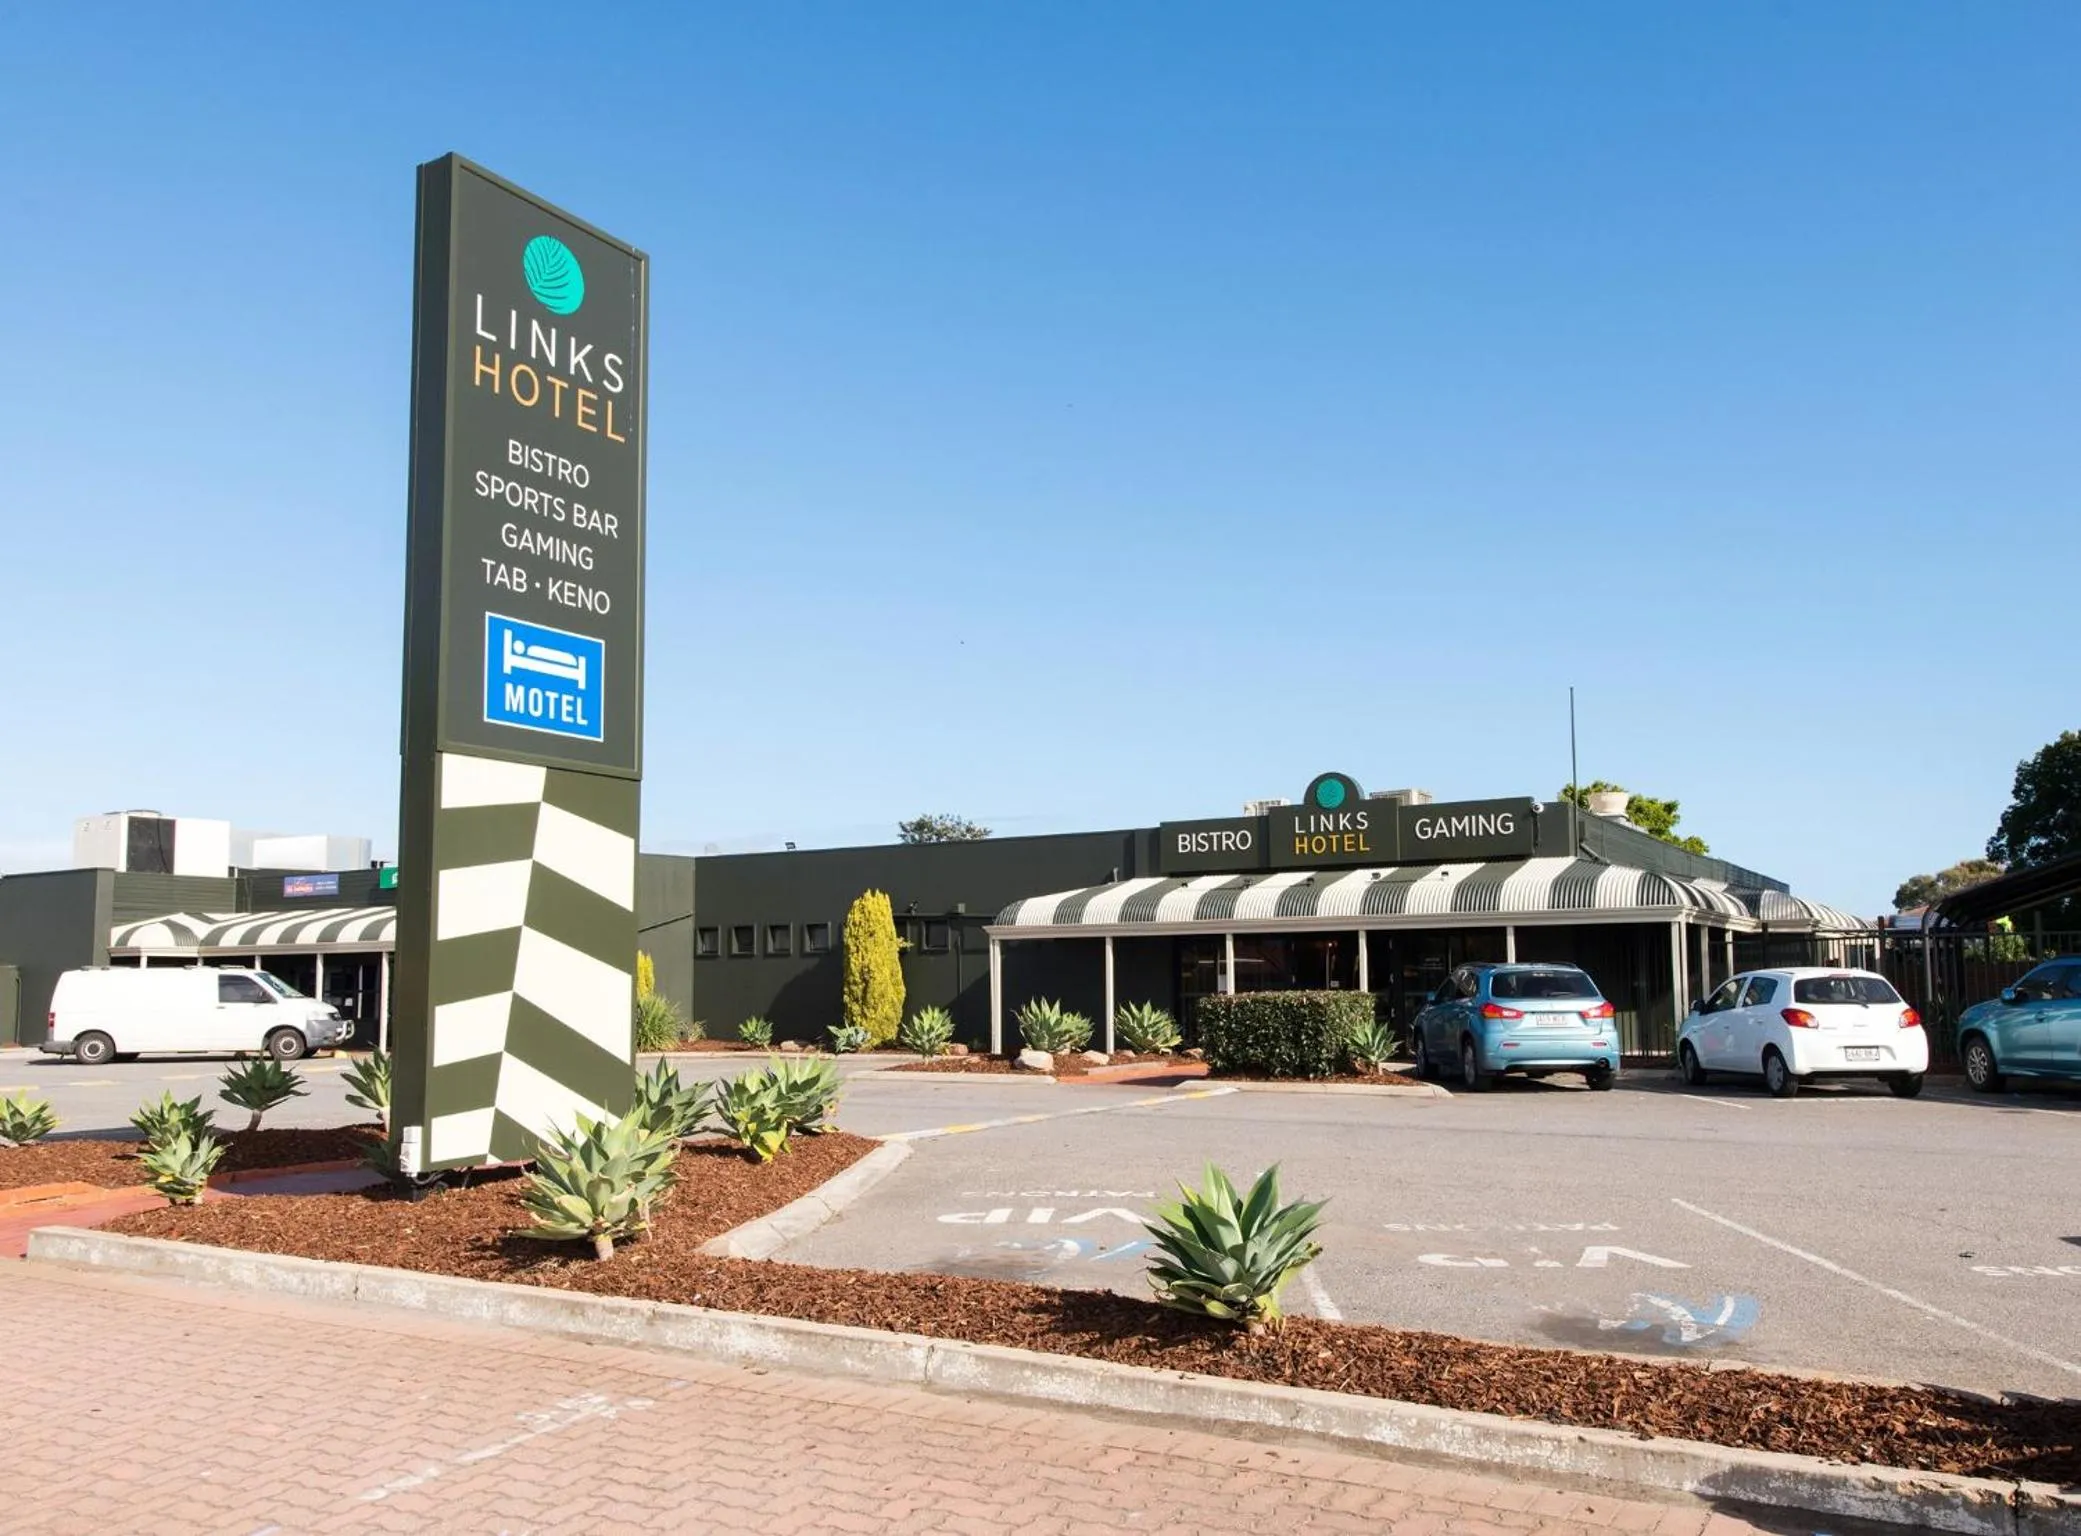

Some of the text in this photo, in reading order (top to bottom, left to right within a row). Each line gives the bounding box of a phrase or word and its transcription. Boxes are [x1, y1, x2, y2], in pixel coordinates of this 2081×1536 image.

[475, 293, 624, 394] LINKS
[474, 344, 626, 443] HOTEL
[508, 439, 590, 488] BISTRO
[475, 470, 619, 539] SPORTS BAR
[501, 522, 594, 570] GAMING
[481, 557, 611, 615] TAB KENO
[504, 682, 588, 726] MOTEL
[1177, 829, 1252, 853] BISTRO
[1294, 811, 1369, 834] LINKS
[1295, 832, 1370, 855] HOTEL
[1415, 812, 1515, 840] GAMING
